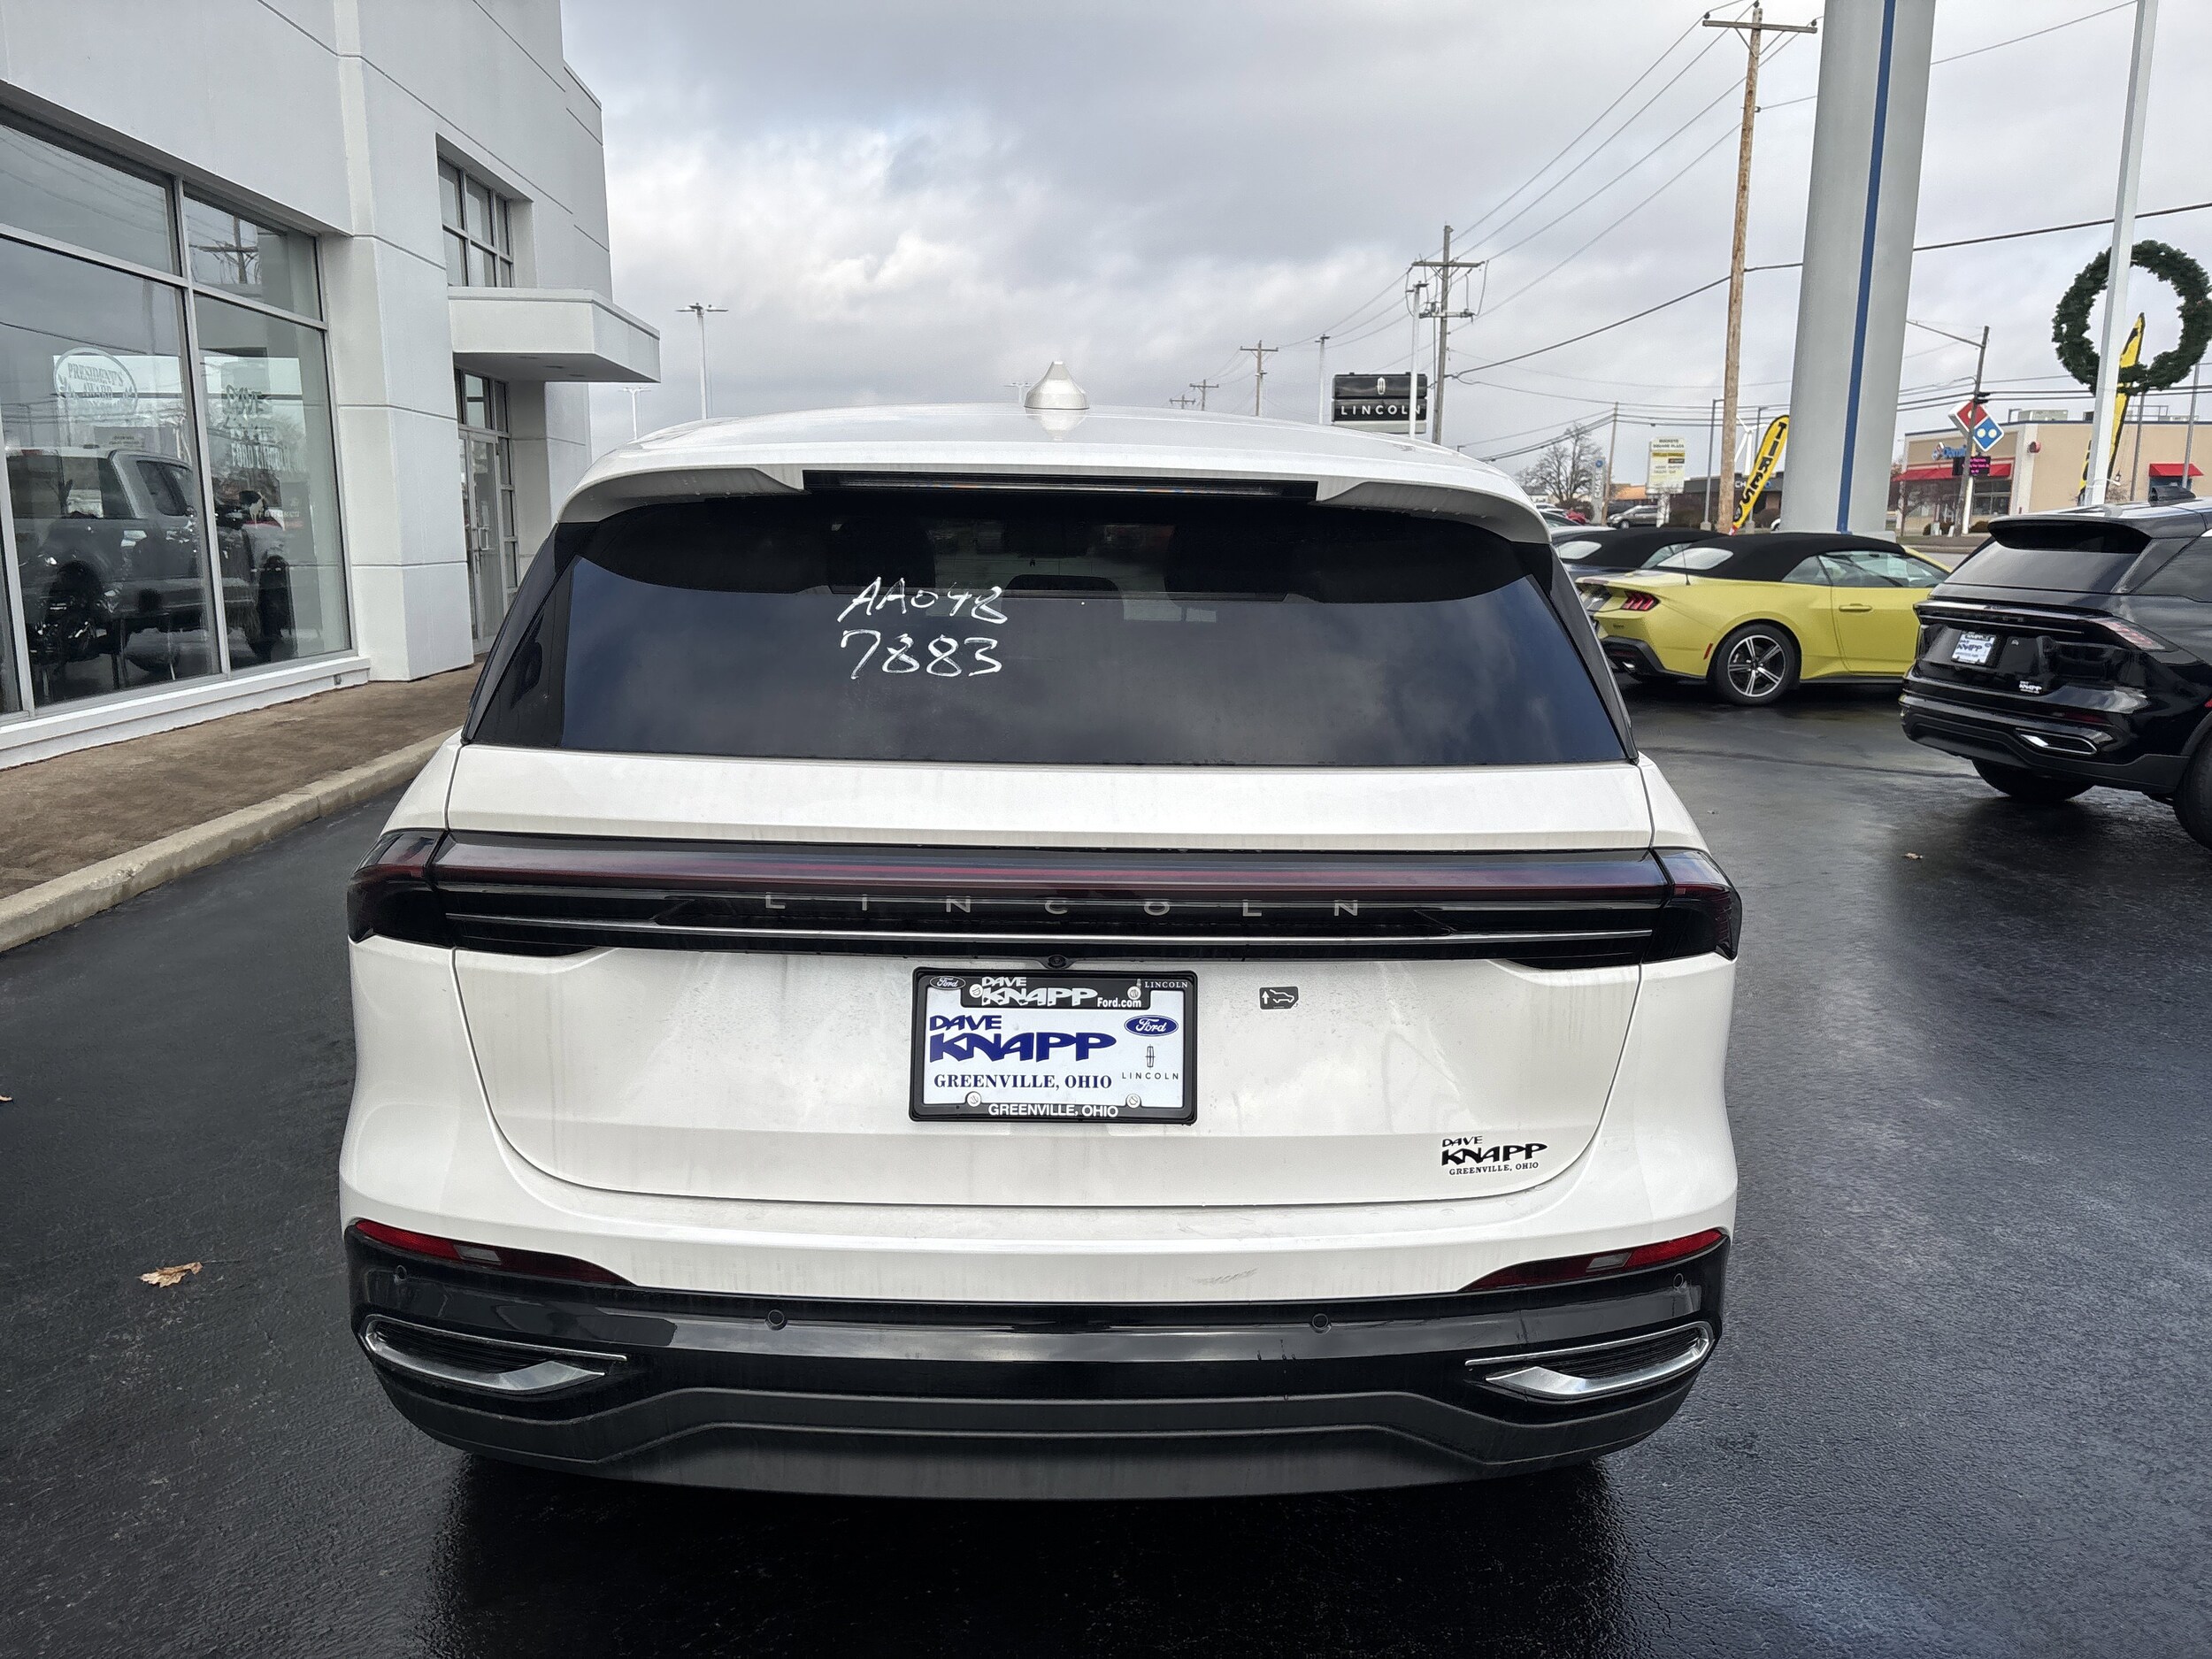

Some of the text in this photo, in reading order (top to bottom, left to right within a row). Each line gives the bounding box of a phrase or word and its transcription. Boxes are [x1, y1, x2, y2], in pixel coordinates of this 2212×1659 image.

[1340, 404, 1421, 415] LINCOLN
[837, 576, 1008, 625] AA048
[841, 629, 1002, 680] 7883
[764, 892, 1358, 917] LINCOLN
[936, 977, 959, 988] Ford
[981, 976, 1027, 987] DAVE
[981, 987, 1142, 1008] KNAPP Ford.com
[929, 1015, 1002, 1032] DAVE
[1135, 1018, 1168, 1033] Ford
[929, 1032, 1117, 1063] KNAPP
[933, 1073, 1113, 1091] GREENVILLE, OHIO
[987, 1103, 1119, 1118] GREENVILLE, OHIO
[1441, 1136, 1483, 1148] DAVE
[1441, 1143, 1548, 1166] KNAPP
[1448, 1161, 1540, 1175] GREENVILLE, OHIO
